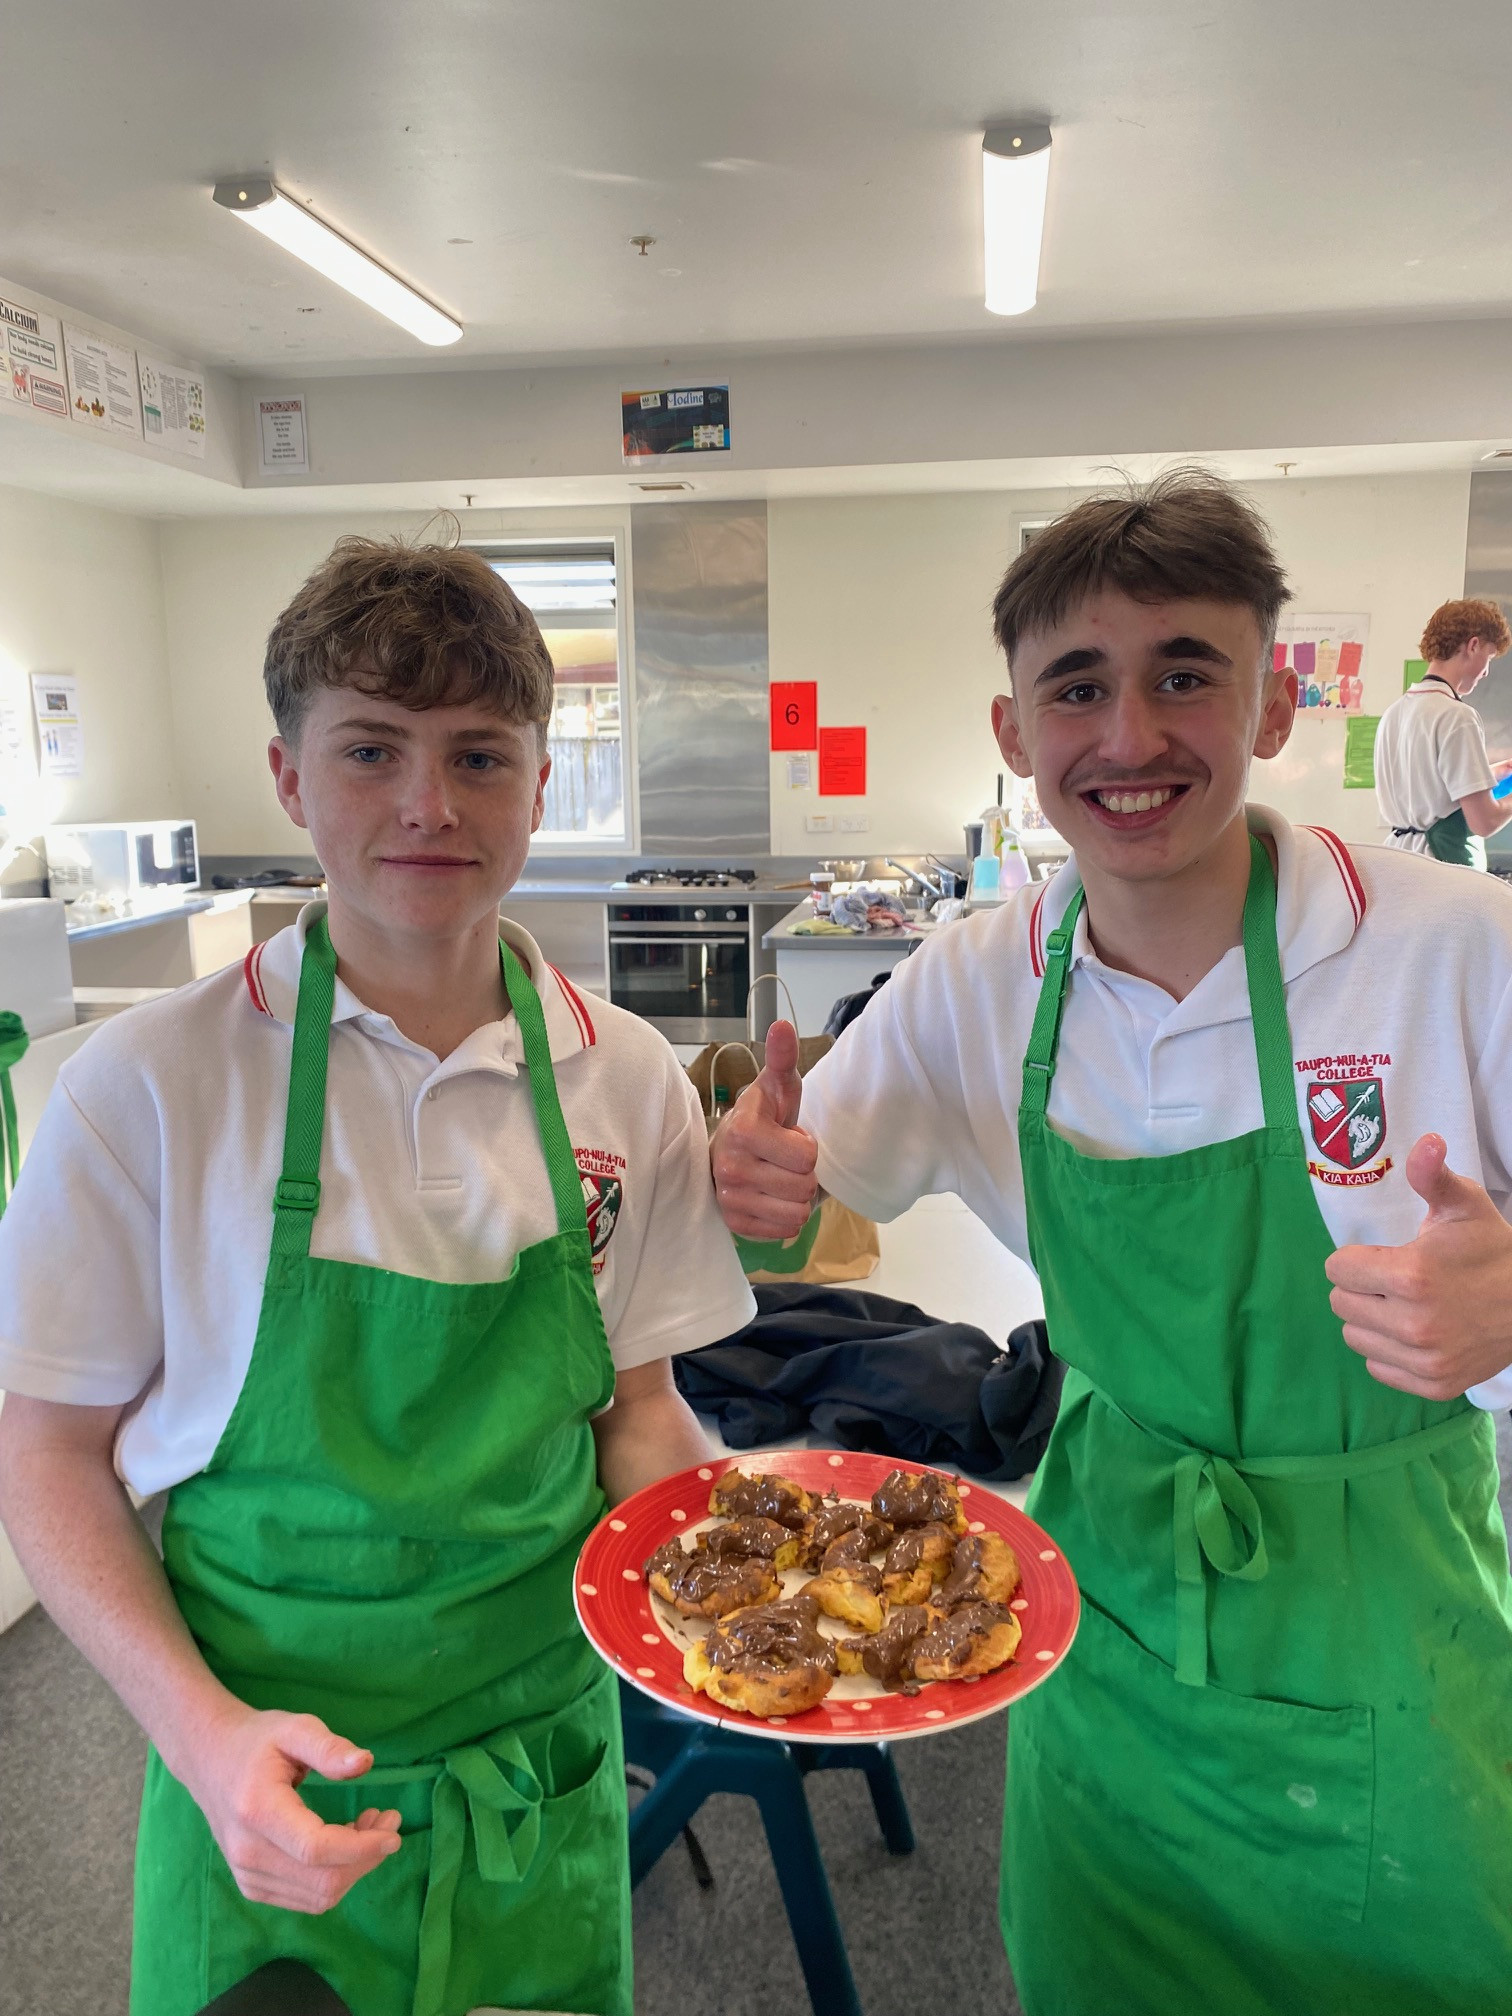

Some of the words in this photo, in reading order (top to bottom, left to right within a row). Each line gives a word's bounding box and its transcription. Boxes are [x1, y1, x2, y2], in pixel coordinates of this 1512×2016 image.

[0, 301, 38, 332] CALCIUM
[671, 391, 704, 407] Iodine
[785, 703, 800, 726] 6
[1295, 1054, 1392, 1073] TAUPO-NUI-A-TIA
[1316, 1066, 1374, 1080] COLLEGE
[573, 1148, 627, 1170] UPO-NUI-A-TIA
[578, 1159, 617, 1175] COLLEGE
[1323, 1172, 1343, 1184] KIA
[1346, 1172, 1380, 1185] KAHA
